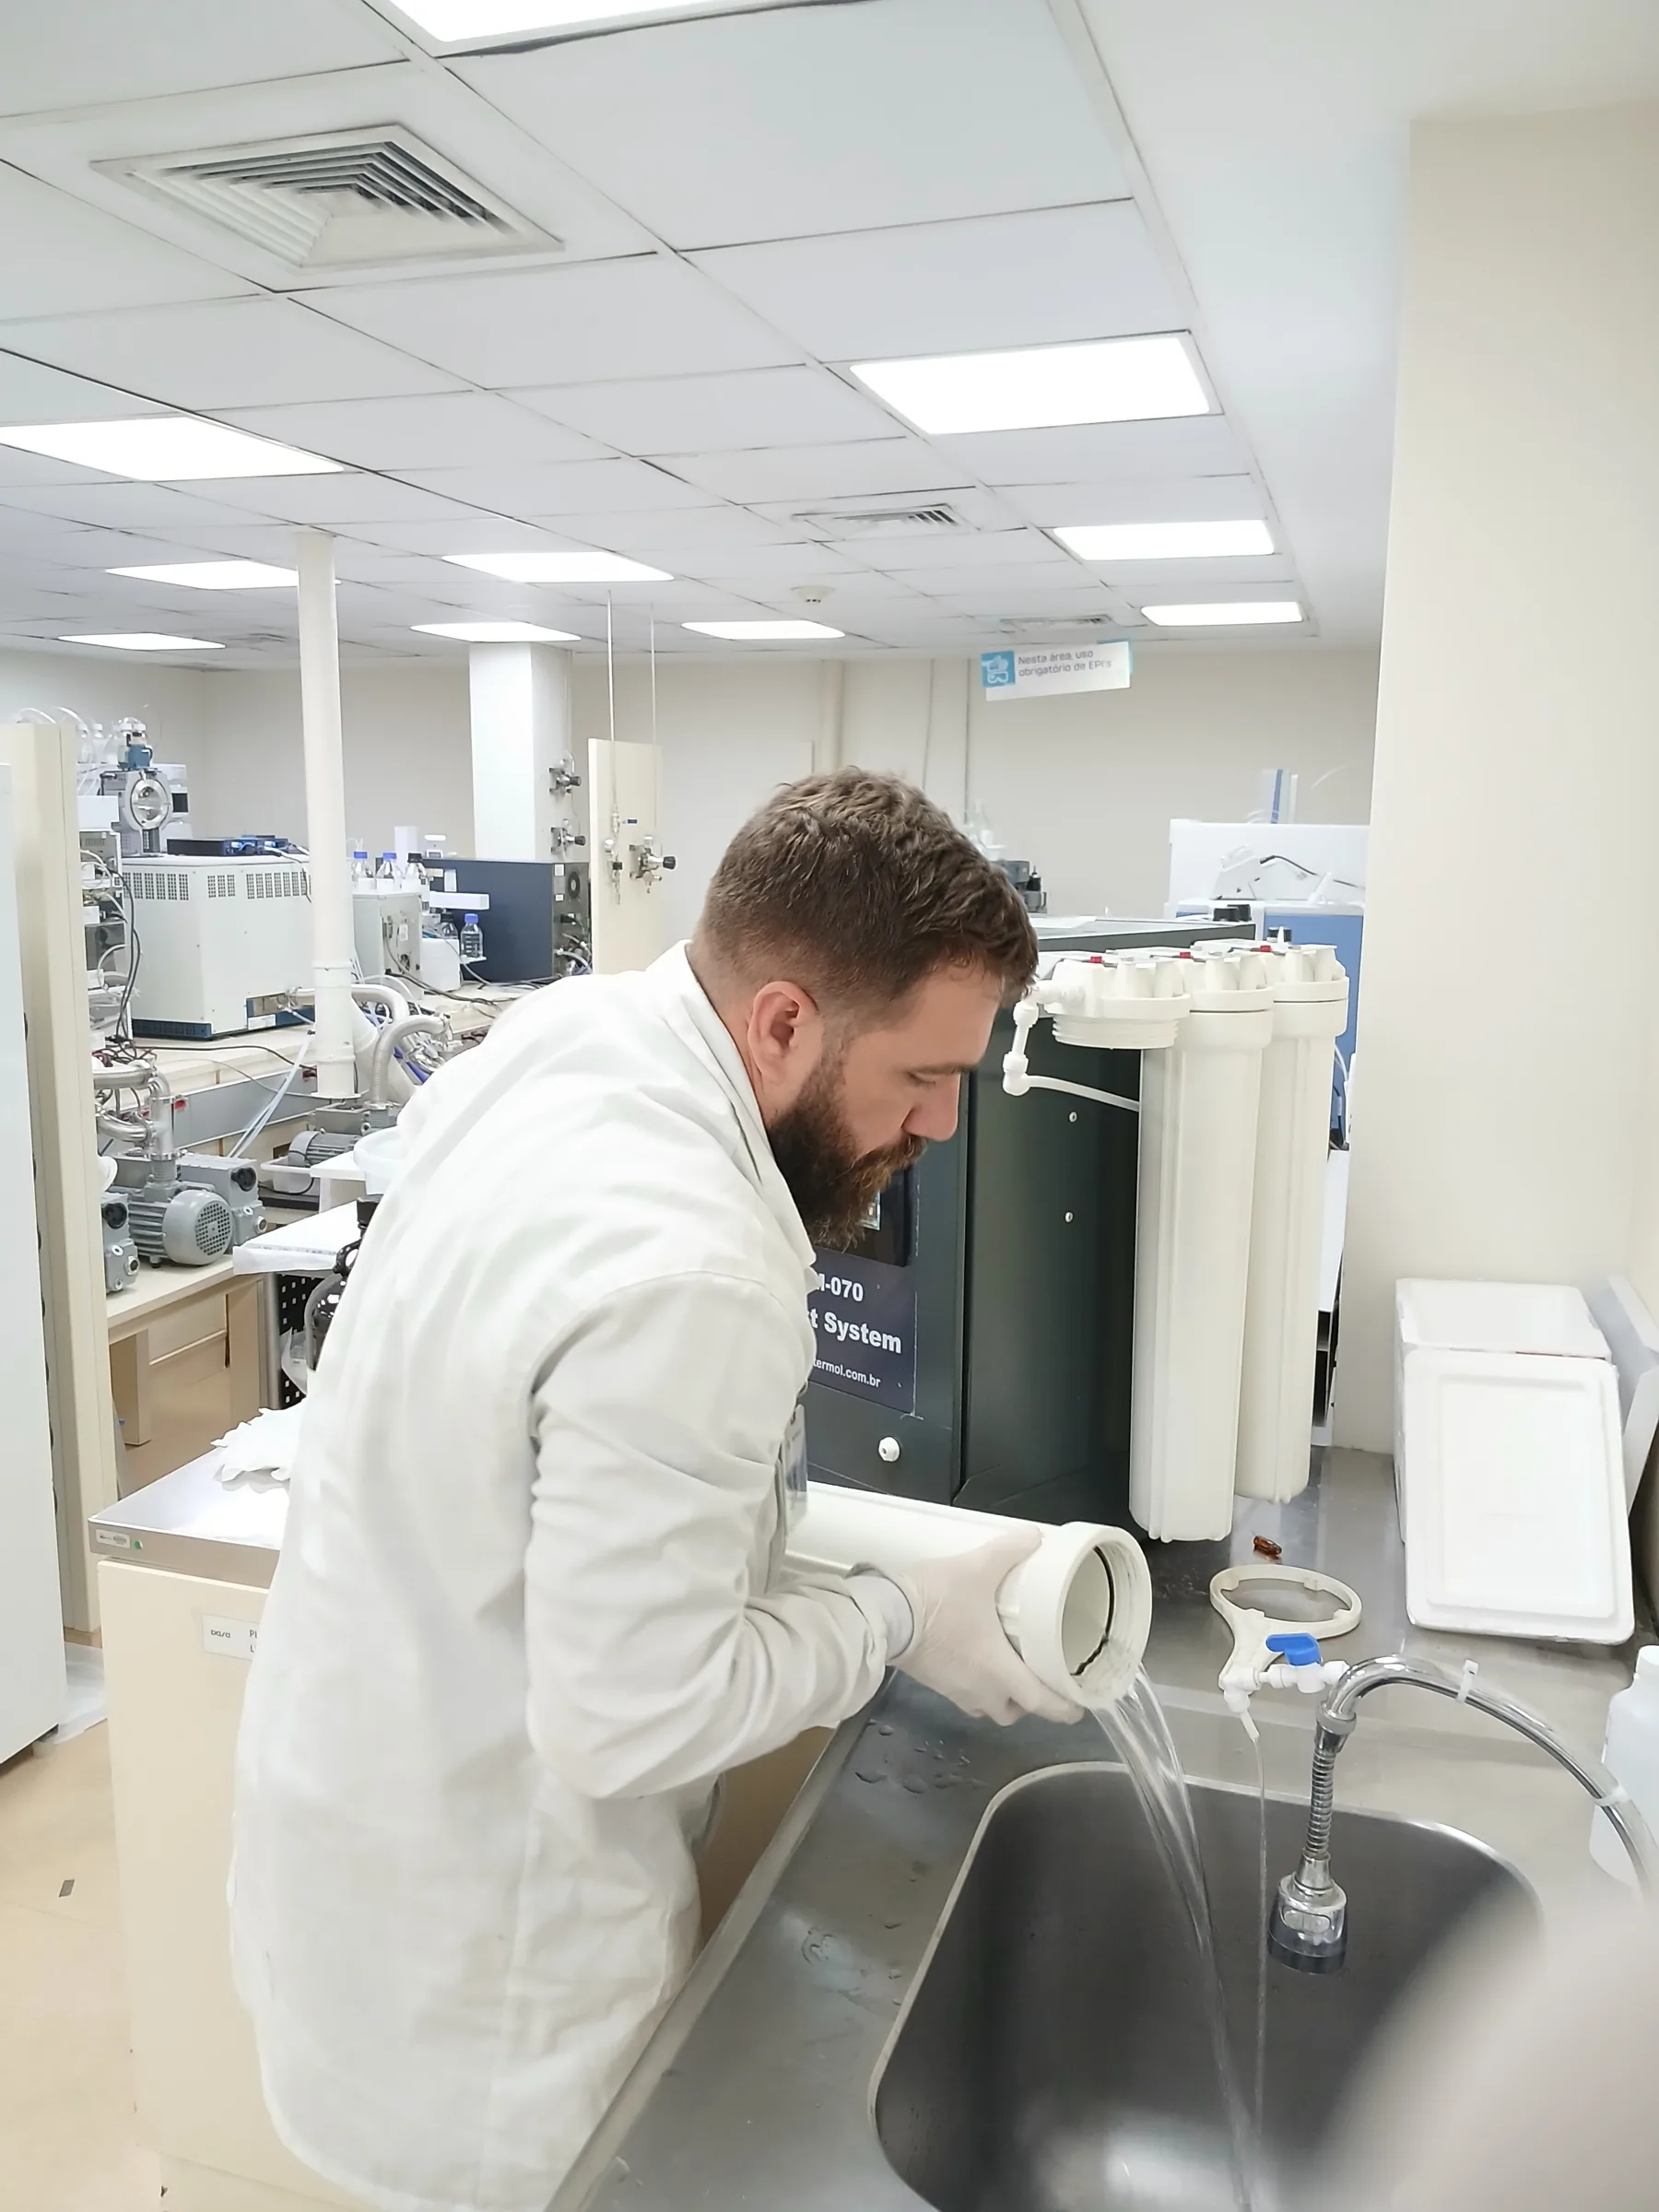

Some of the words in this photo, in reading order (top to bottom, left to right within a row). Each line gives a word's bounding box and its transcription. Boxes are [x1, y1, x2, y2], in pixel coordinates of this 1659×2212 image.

[1018, 654, 1047, 665] Nesta
[1075, 650, 1094, 659] uso
[1018, 664, 1071, 677] obrigatório
[1073, 662, 1086, 671] de
[823, 1311, 901, 1354] System
